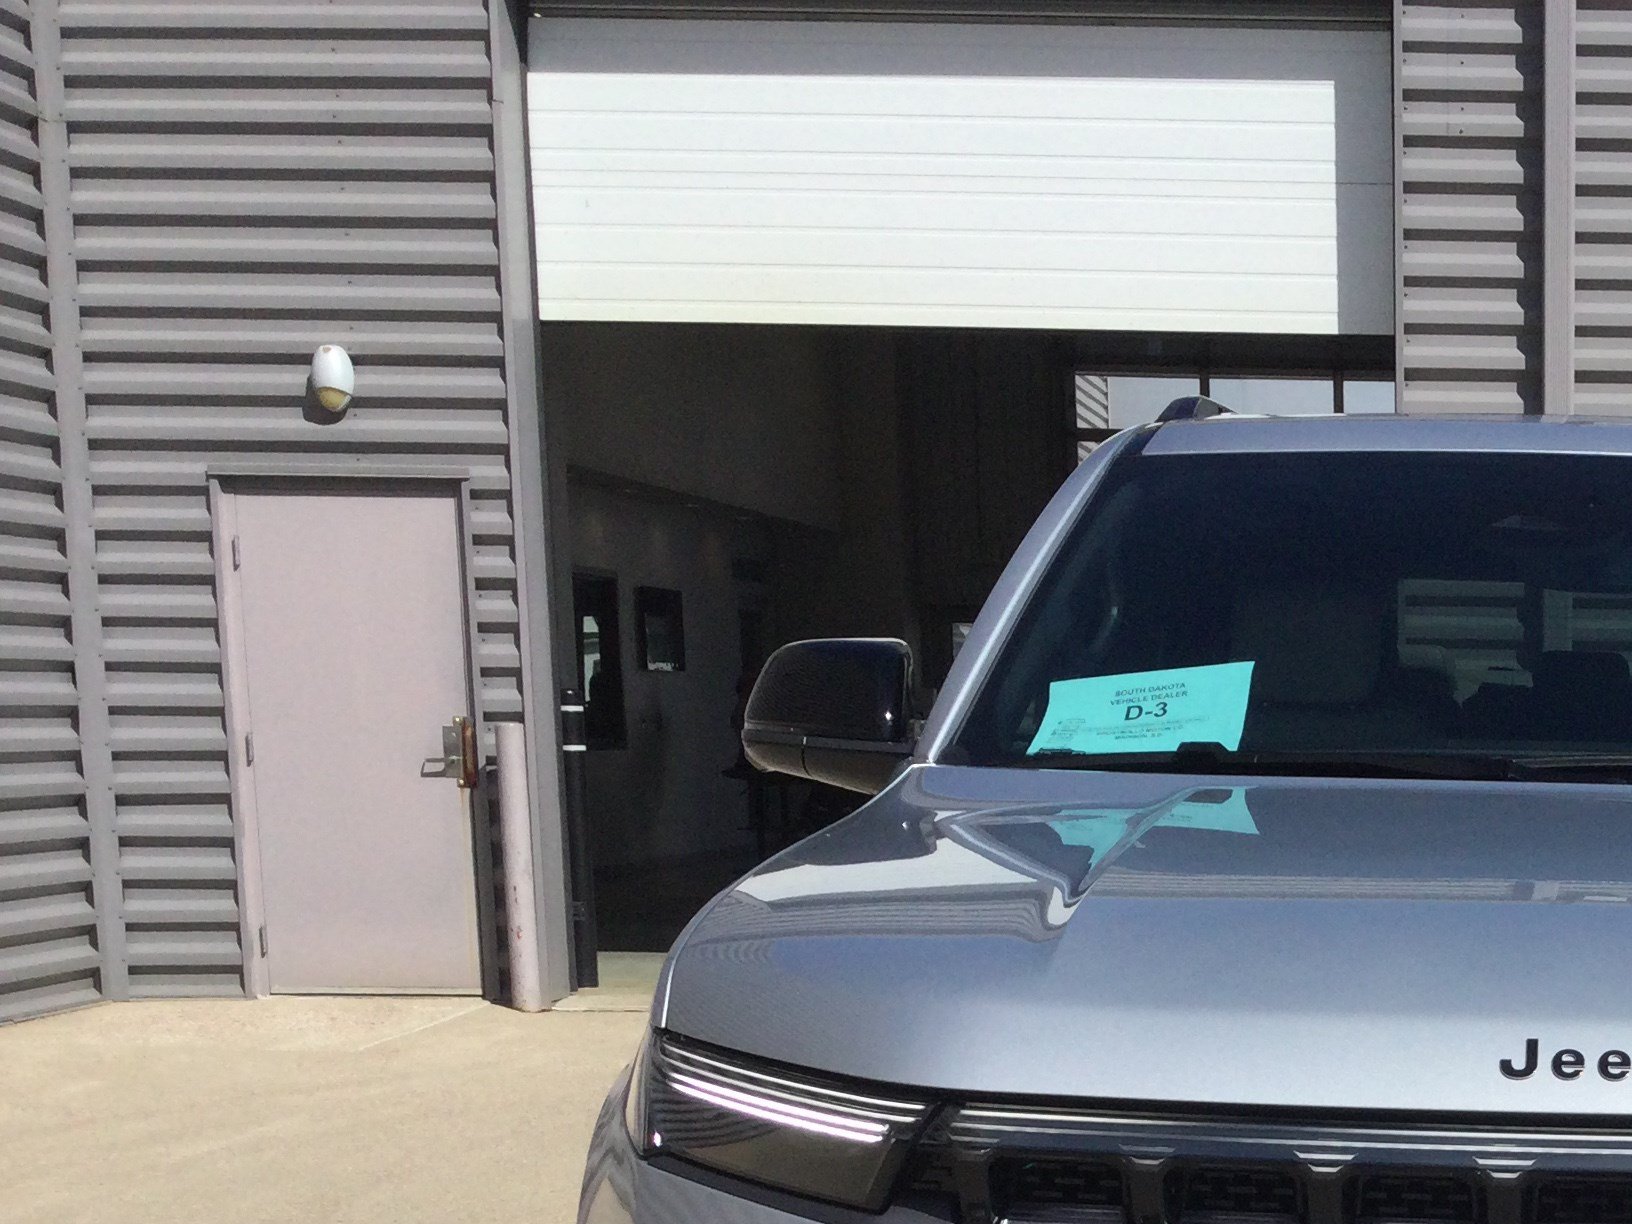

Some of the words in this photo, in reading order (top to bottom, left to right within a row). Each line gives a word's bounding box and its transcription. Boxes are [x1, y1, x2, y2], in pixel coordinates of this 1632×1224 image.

[1115, 686, 1146, 697] SOUTH
[1148, 682, 1186, 693] DAKOTA
[1110, 694, 1149, 705] VEHICLE
[1151, 690, 1188, 701] DEALER
[1124, 702, 1168, 721] D-3
